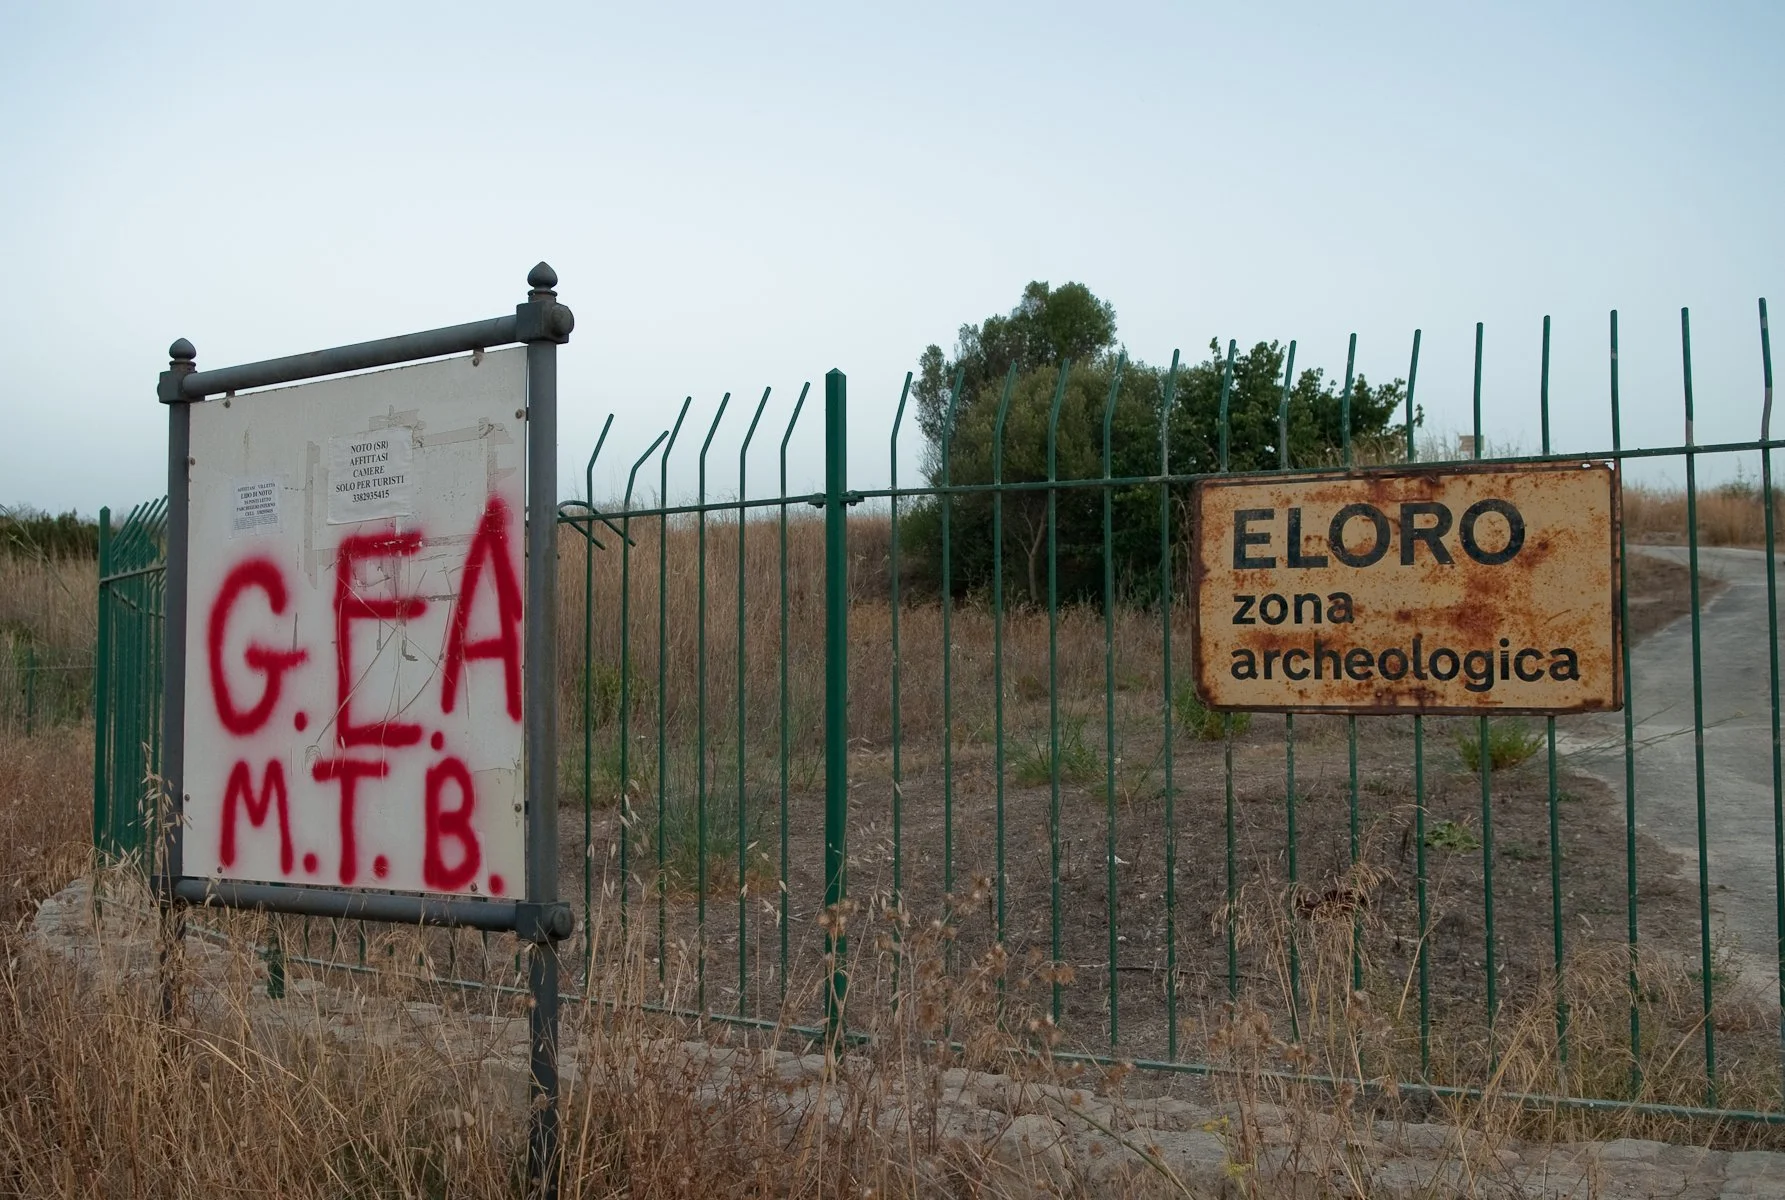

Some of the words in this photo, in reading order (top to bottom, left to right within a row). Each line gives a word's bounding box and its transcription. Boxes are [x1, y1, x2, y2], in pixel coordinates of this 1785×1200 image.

[351, 443, 373, 454] NOTO
[373, 440, 389, 452] (SR)
[350, 452, 389, 466] AFFITTASI
[353, 465, 385, 478] CAMERE
[335, 483, 356, 493] SOLO
[356, 479, 371, 490] PER
[372, 475, 404, 488] TURISTI
[352, 489, 390, 503] 3382935415
[1232, 498, 1526, 570] ELORO
[1232, 589, 1355, 626] zona
[1230, 632, 1581, 693] archeologica
